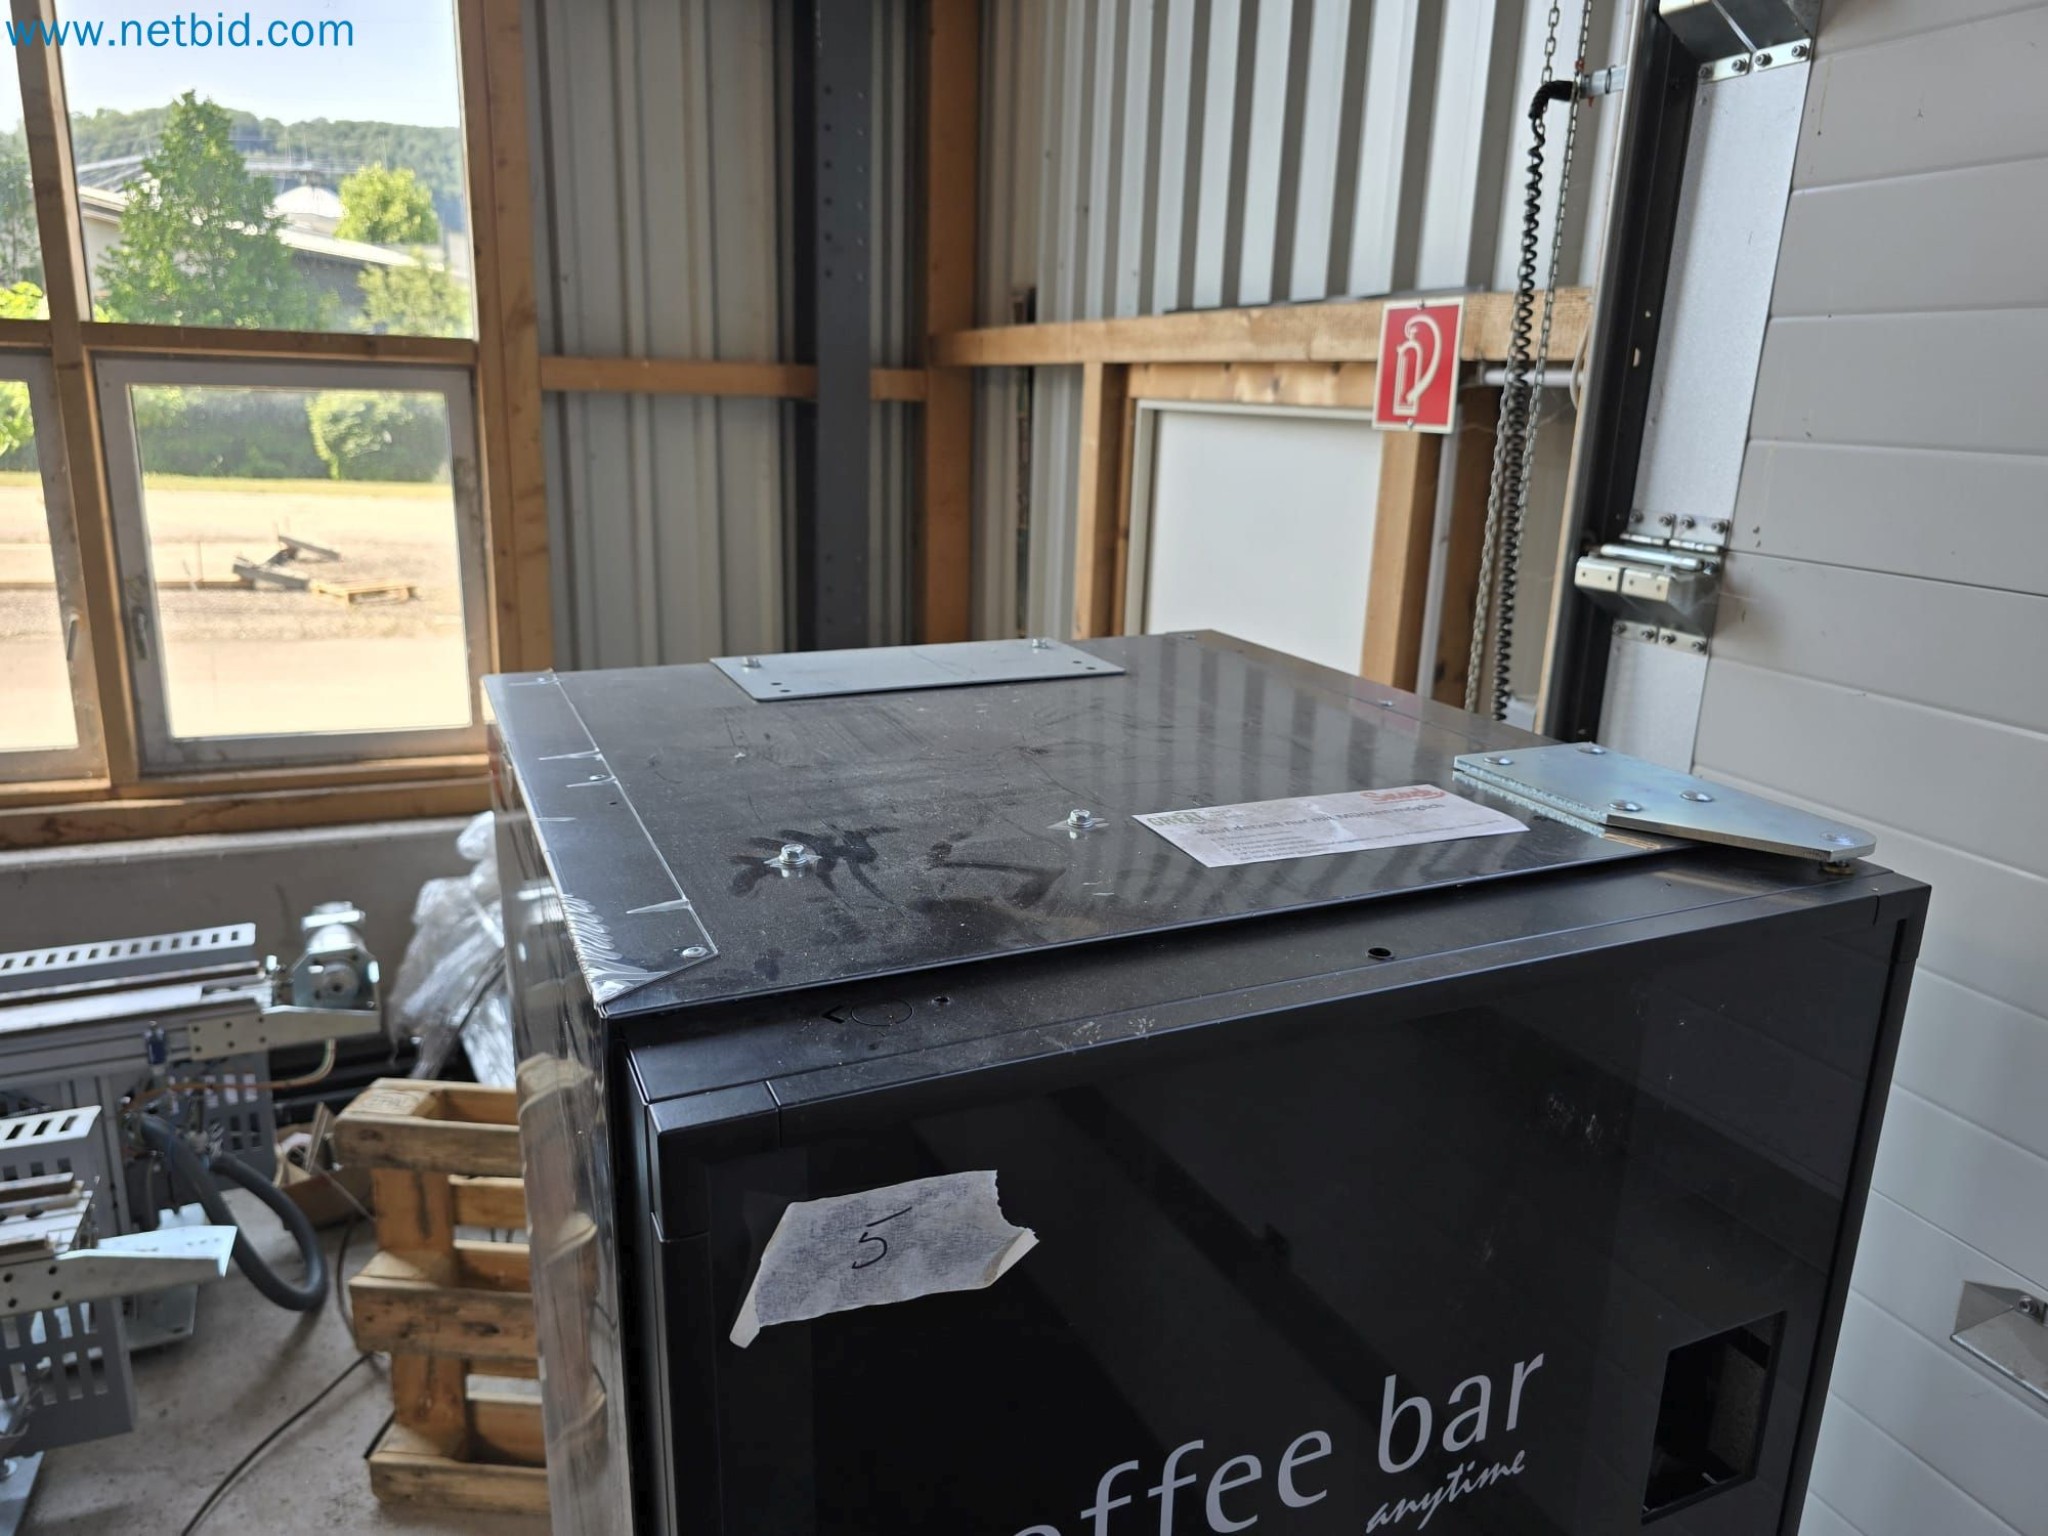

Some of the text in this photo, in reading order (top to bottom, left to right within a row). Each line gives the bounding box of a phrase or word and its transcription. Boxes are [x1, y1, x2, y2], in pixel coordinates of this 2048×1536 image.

[851, 1206, 912, 1269] 5
[1012, 1353, 1544, 1536] ffee bar
[1365, 1450, 1526, 1534] anytime
